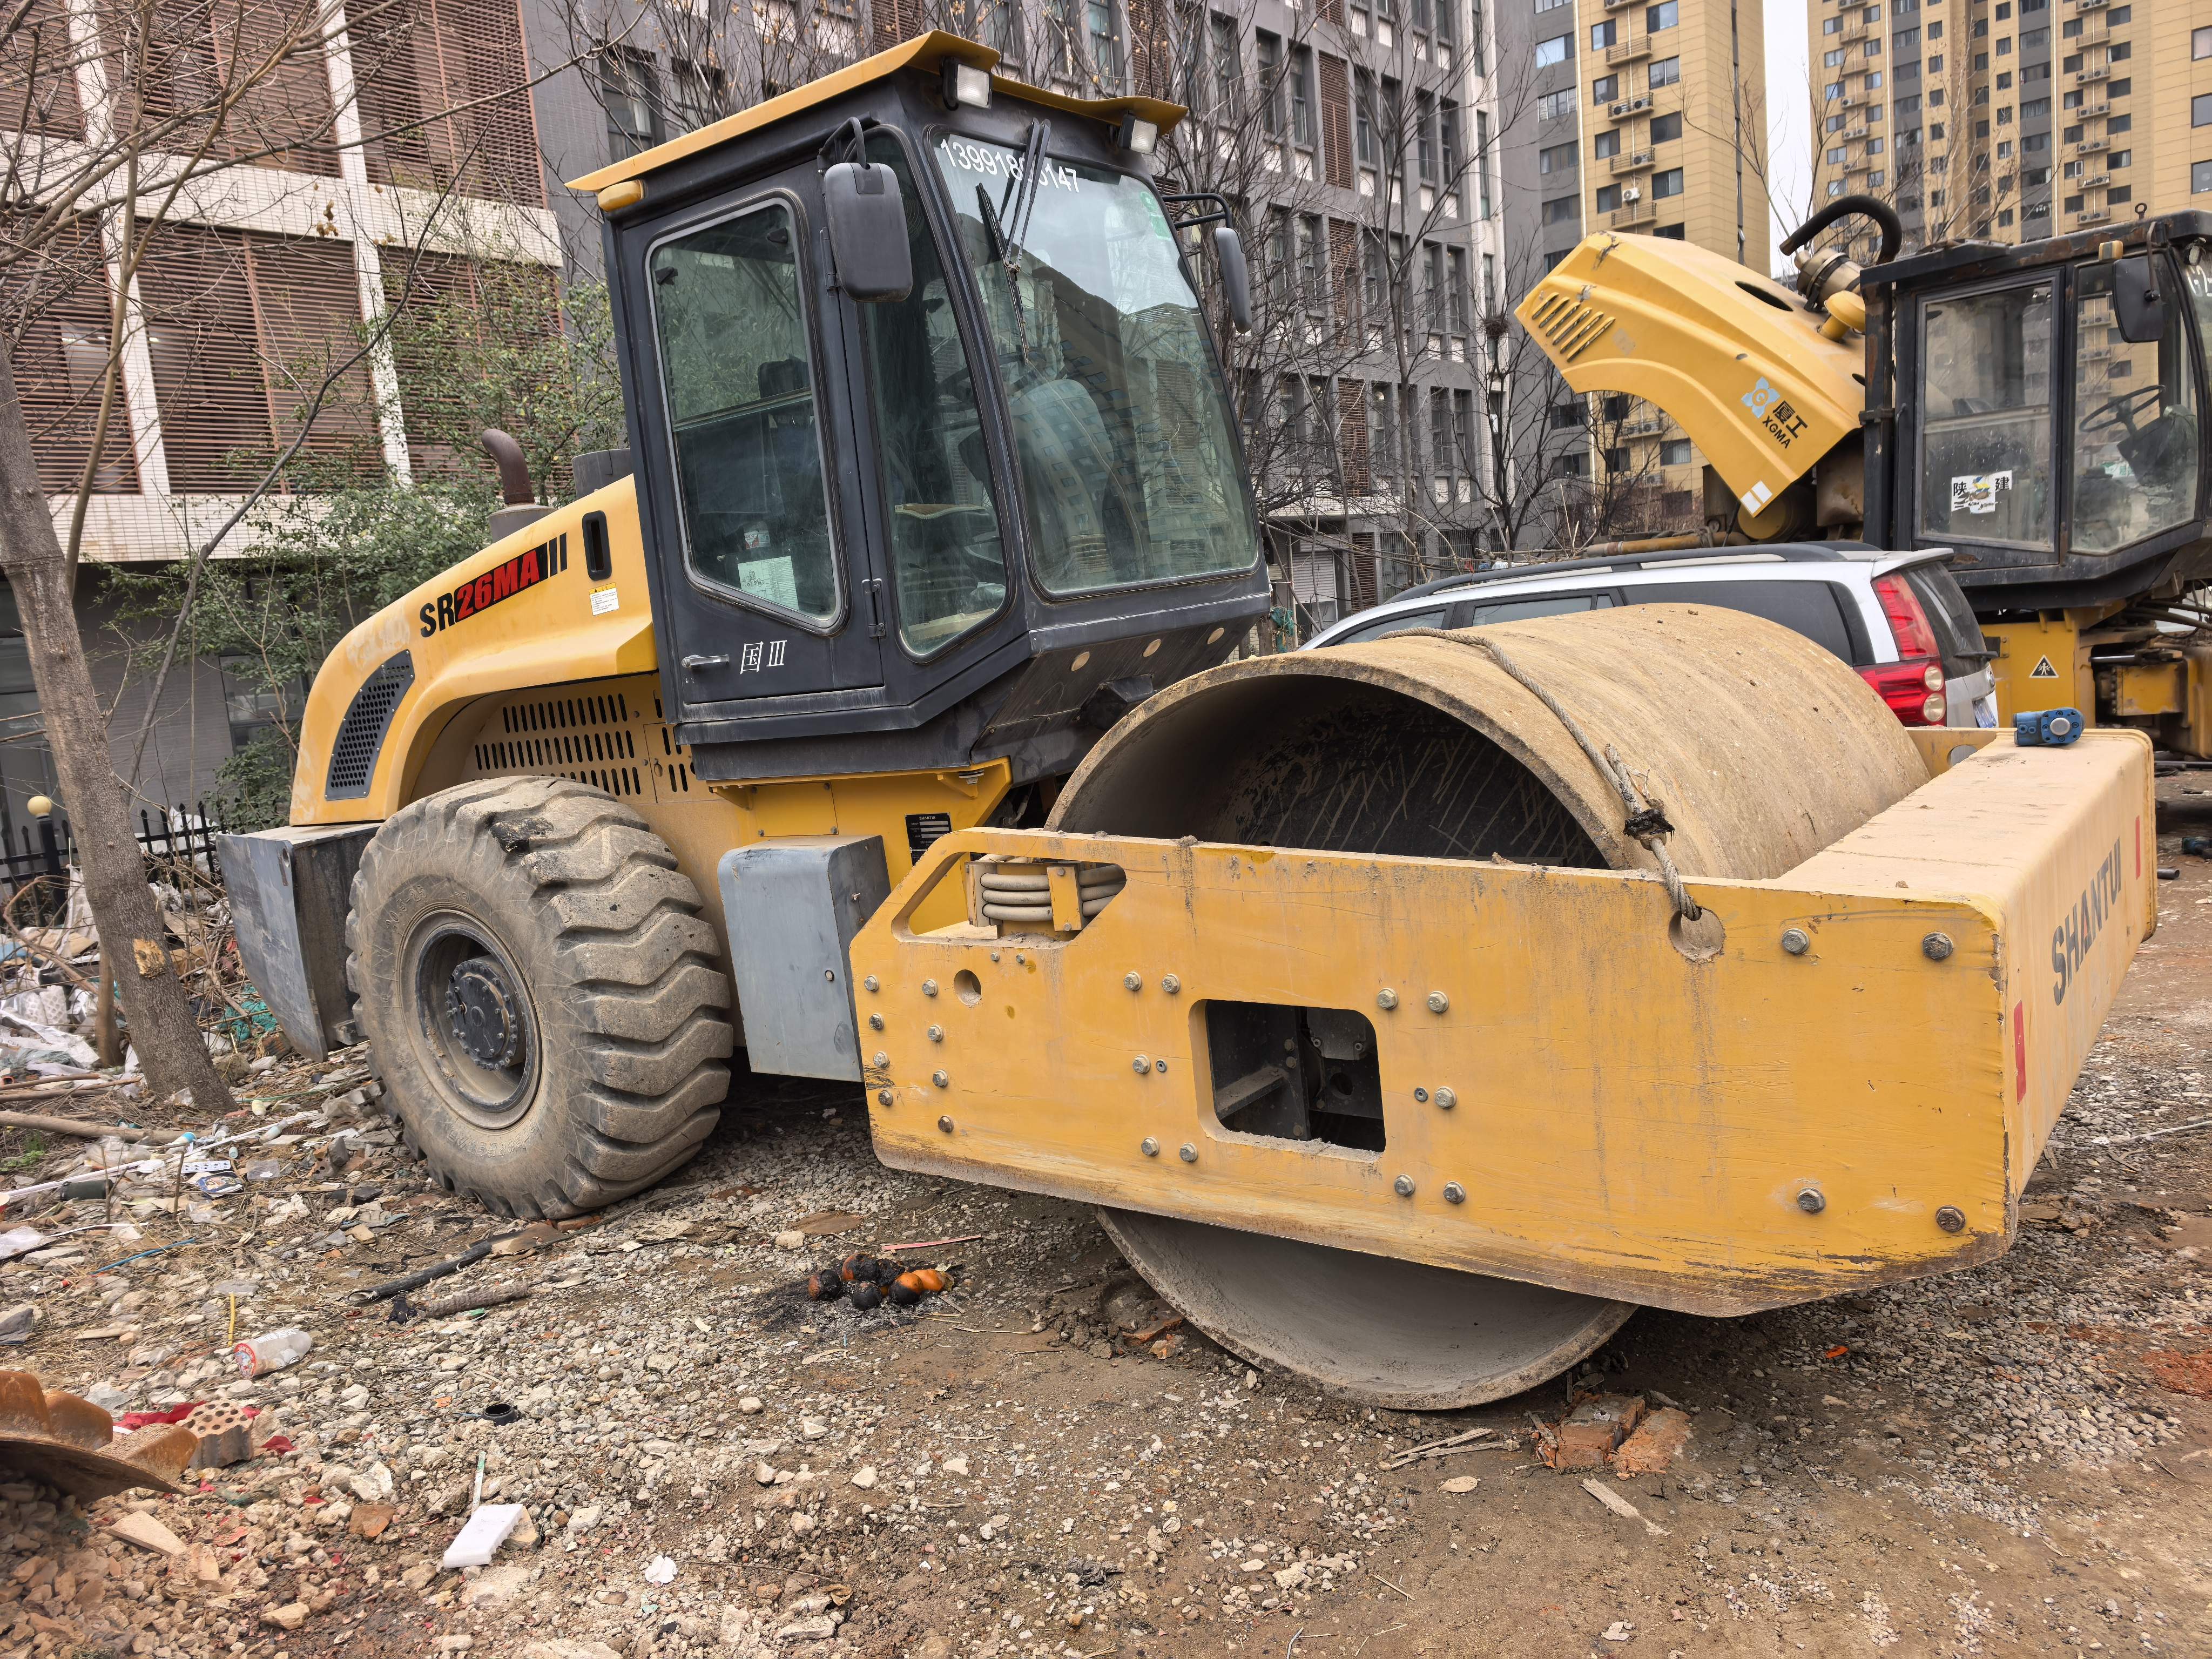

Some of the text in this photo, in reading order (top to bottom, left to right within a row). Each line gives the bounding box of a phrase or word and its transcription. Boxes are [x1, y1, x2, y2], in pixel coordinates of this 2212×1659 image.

[1762, 415, 1791, 449] XGMA
[1773, 400, 1808, 439] 厦工
[420, 550, 540, 638] SR26MA
[2052, 836, 2121, 1006] SHANTUI
